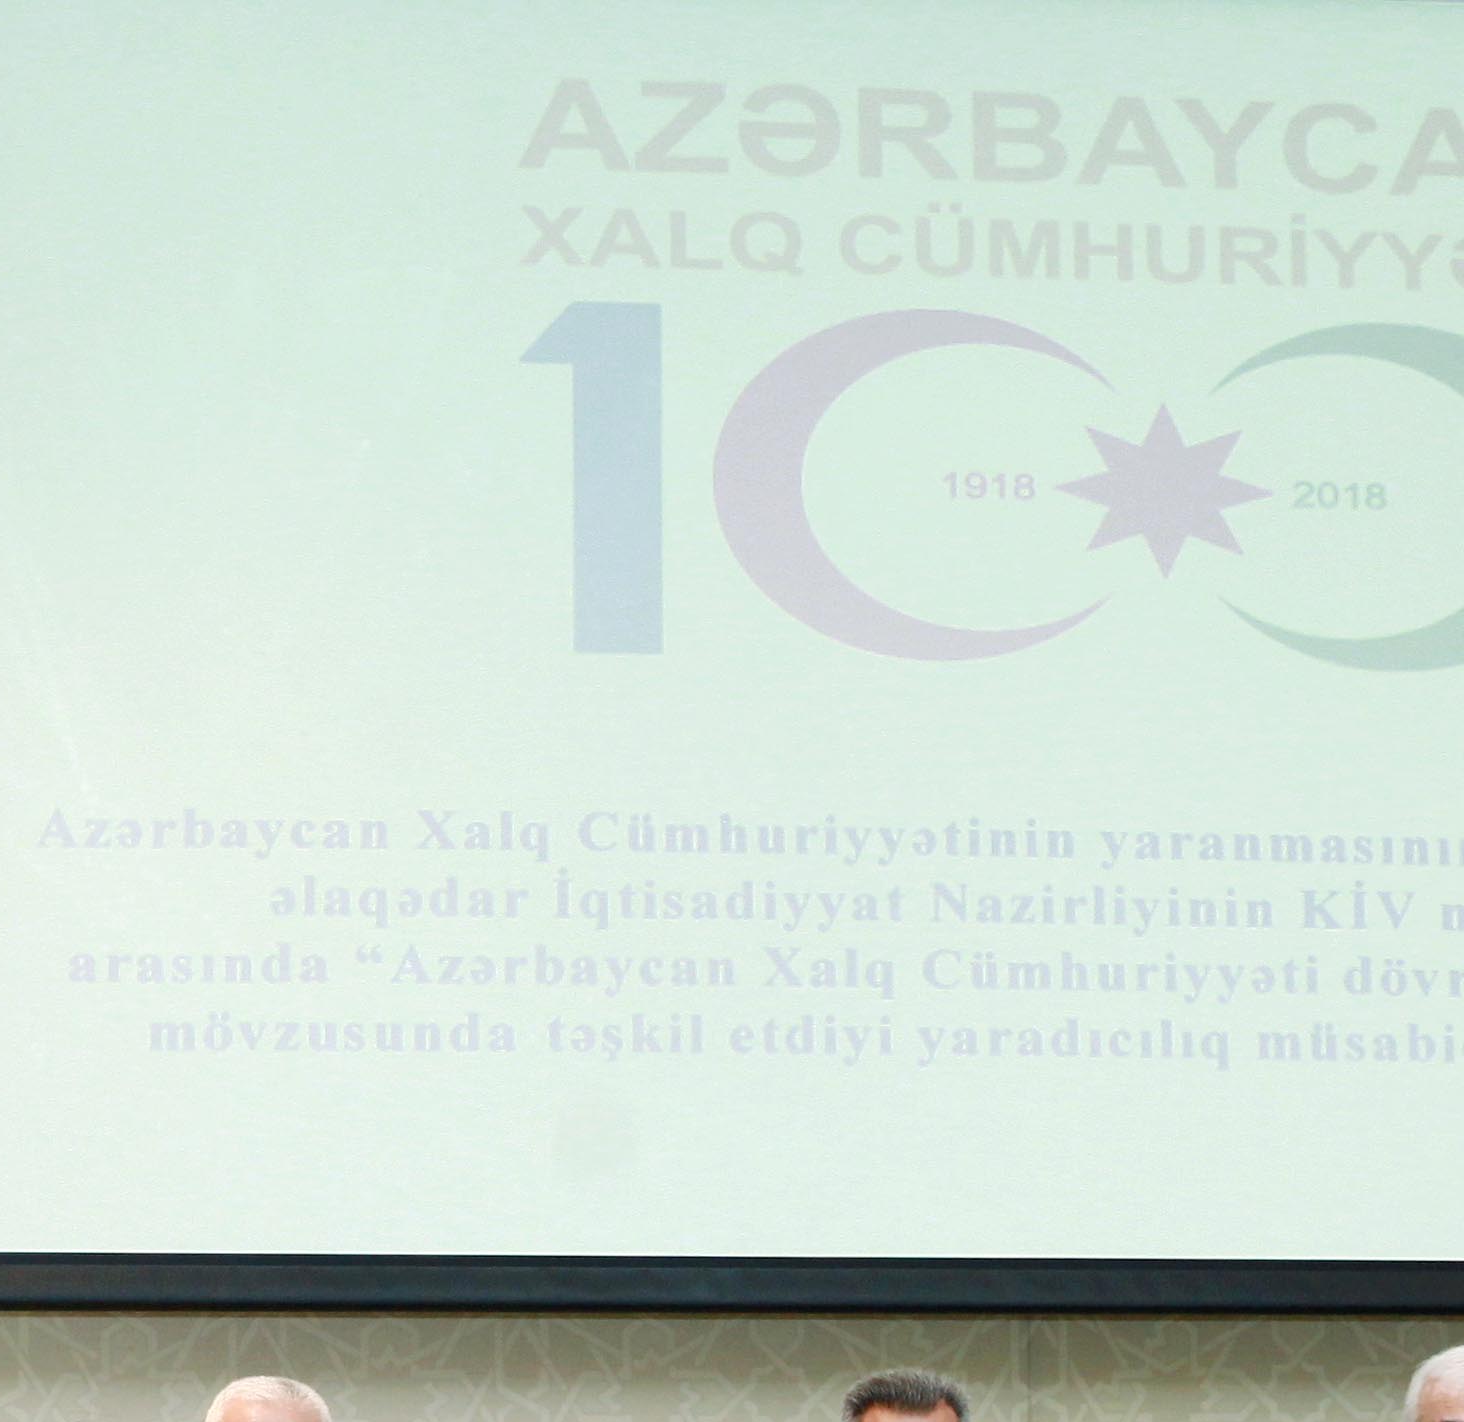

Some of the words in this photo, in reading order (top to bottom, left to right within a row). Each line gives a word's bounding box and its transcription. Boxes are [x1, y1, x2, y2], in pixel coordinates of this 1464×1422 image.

[520, 205, 804, 277] XALQ
[941, 469, 1037, 503] 1918
[1291, 479, 1389, 512] 2018
[37, 808, 388, 860] Azərbaycan
[416, 809, 550, 867] Xalq
[577, 811, 1074, 867] Cümhuriyyətinin
[270, 875, 529, 929] əlaqədar
[554, 867, 904, 933] İqtisadiyyat
[931, 882, 1273, 937] Nazirliyinin
[1301, 879, 1415, 932] KİV
[69, 942, 328, 986] arasında
[355, 944, 736, 998] “Azərbaycan
[764, 946, 894, 1000] Xalq
[923, 948, 1318, 1005] Cümhuriyyəti
[150, 1011, 516, 1053] mövzusunda
[547, 1013, 703, 1062] təşkil
[730, 1014, 892, 1067] etdiyi
[917, 1018, 1229, 1072] yaradıcılıq
